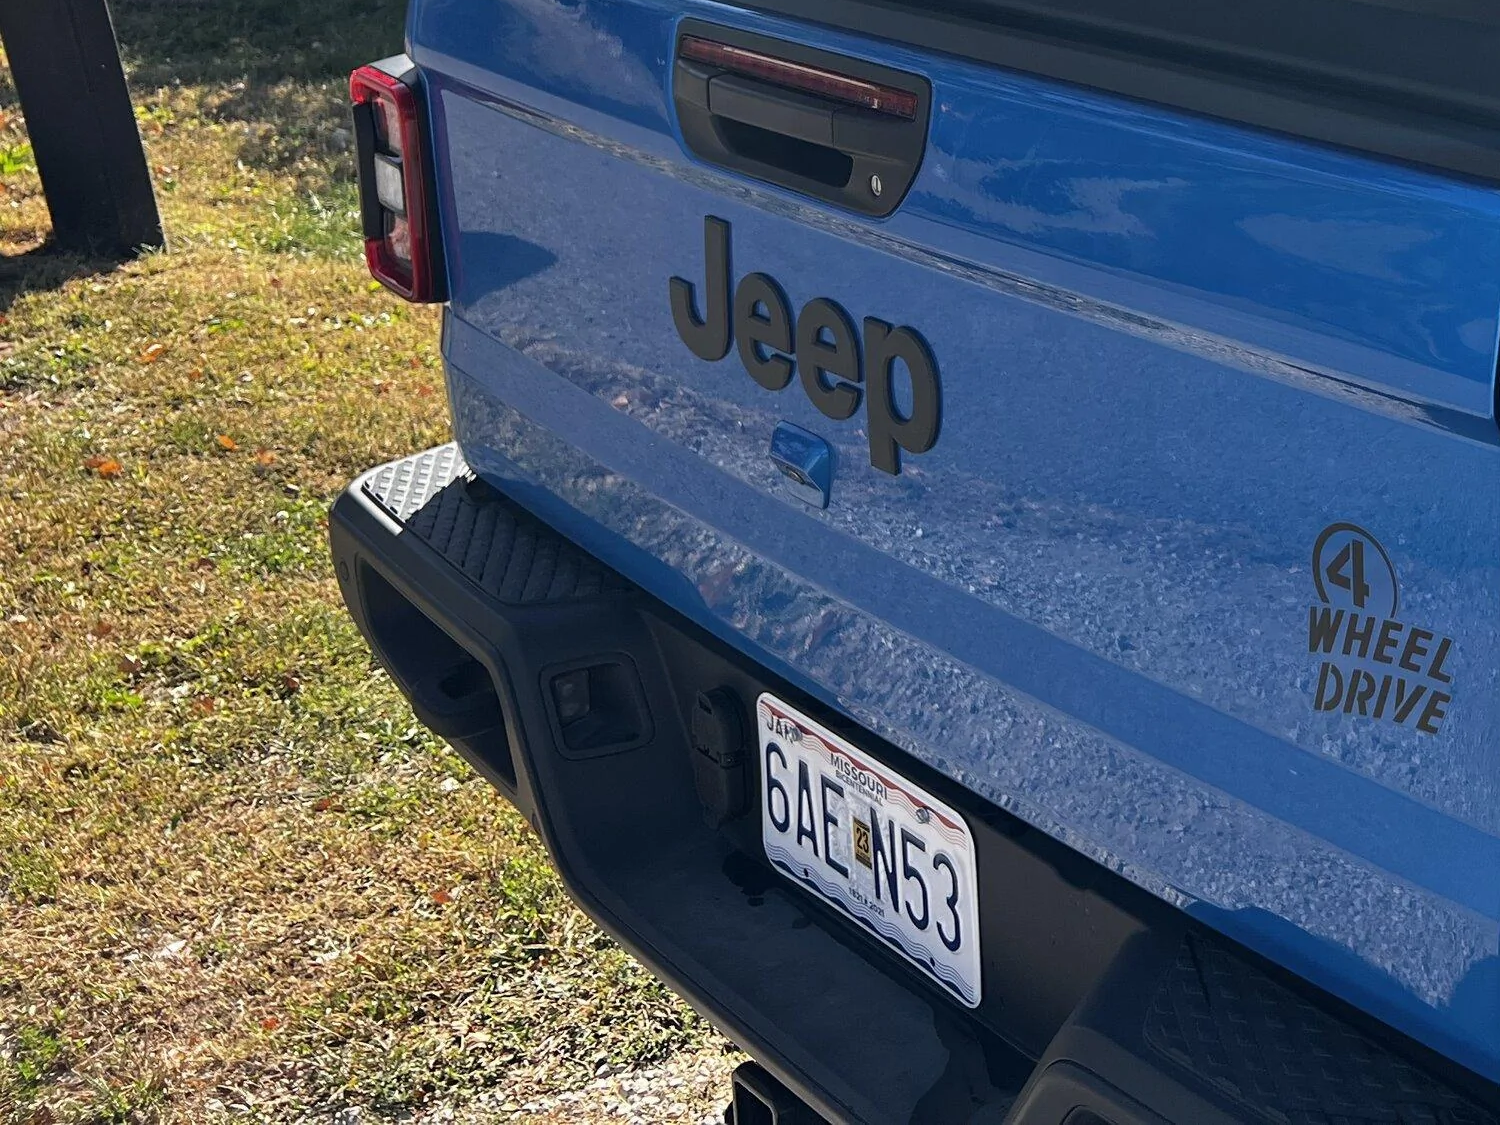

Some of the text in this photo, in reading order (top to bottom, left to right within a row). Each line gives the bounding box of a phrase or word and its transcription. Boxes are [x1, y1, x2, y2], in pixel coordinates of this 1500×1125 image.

[669, 214, 943, 477] Jeep
[1326, 539, 1370, 608] 4
[1308, 606, 1453, 684] WHEEL
[1314, 661, 1452, 735] DRIVE
[830, 752, 888, 801] MISSOURI
[766, 741, 962, 953] 6AE N53
[855, 825, 870, 854] 23
